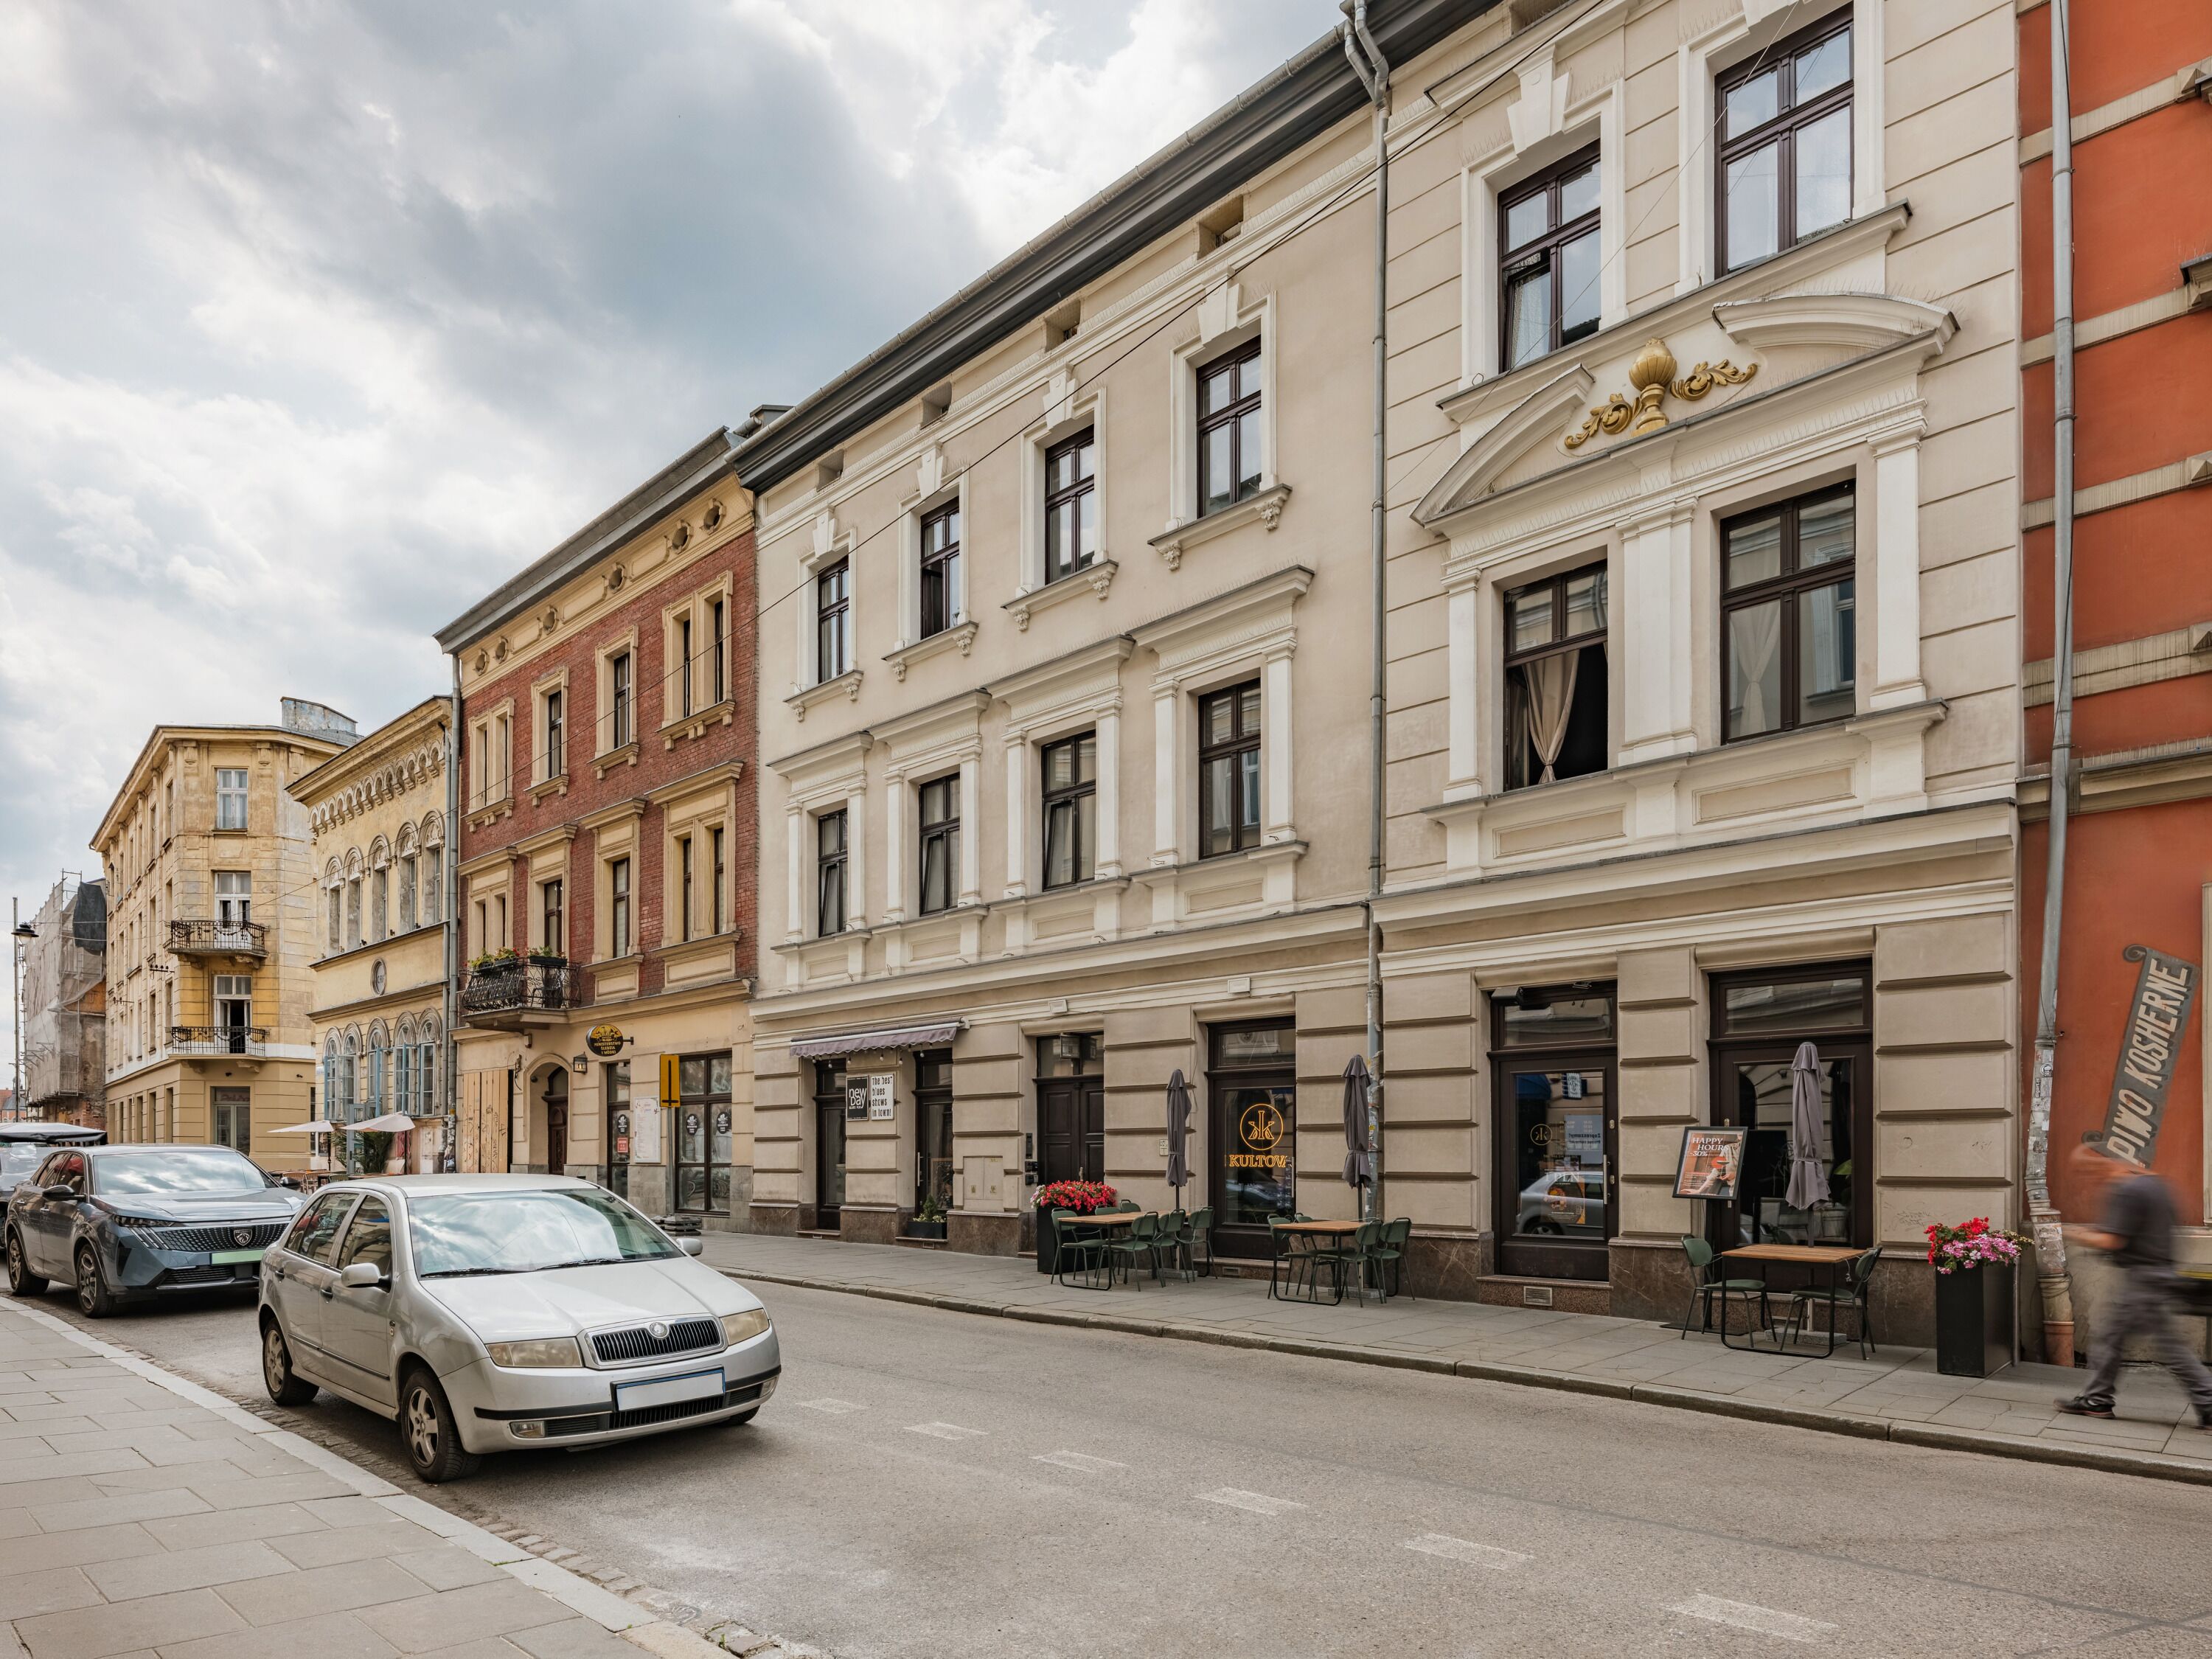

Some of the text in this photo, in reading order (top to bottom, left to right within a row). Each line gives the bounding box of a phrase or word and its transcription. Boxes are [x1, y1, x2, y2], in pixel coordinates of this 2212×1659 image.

[872, 1098, 888, 1107] shows
[2107, 959, 2188, 1169] PIWO KOSHERNE
